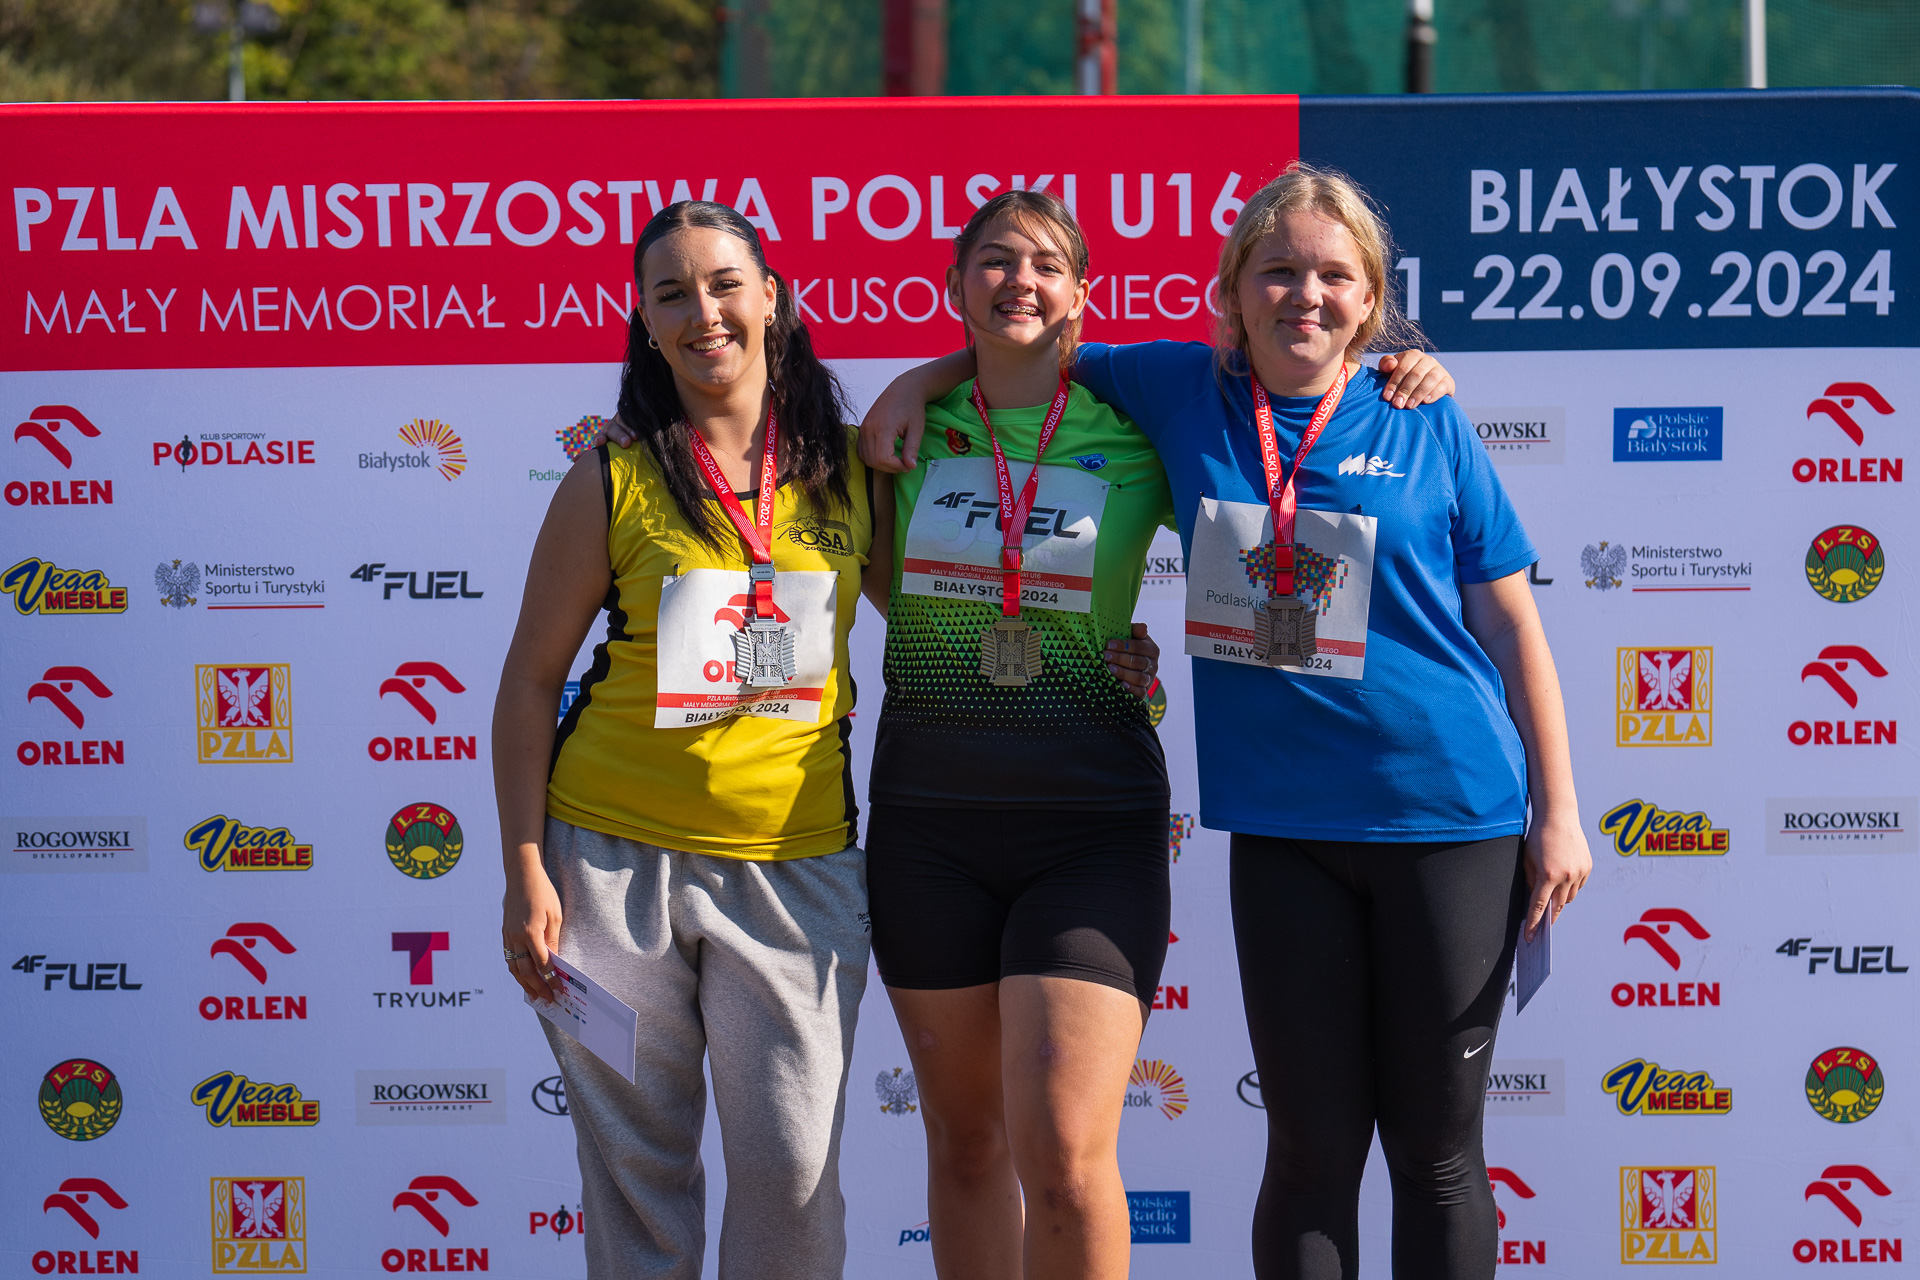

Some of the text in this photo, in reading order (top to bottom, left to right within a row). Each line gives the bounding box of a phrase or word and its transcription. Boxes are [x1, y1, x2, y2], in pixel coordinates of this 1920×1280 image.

[1470, 162, 1899, 235] BIAŁYSTOK
[12, 185, 198, 252] PZLA
[811, 174, 1078, 241] POLSI
[1110, 171, 1246, 239] U16
[1395, 249, 1896, 321] 1-22.09.2024
[24, 288, 178, 336] MAŁY
[199, 284, 505, 334] MEMORIAŁ
[1475, 421, 1547, 440] OWSKI
[1659, 413, 1709, 425] Polskie
[200, 432, 266, 441] KLUB SPORTOWY
[1659, 425, 1709, 439] Radio
[153, 440, 316, 467] PODLASIE
[358, 450, 431, 473] Białystok
[1263, 433, 1277, 471] POLSKI
[529, 468, 567, 482] Podlas
[1792, 457, 1903, 483] ORLEN
[4, 480, 114, 507] ORLEN
[763, 466, 773, 502] POLSKI
[997, 454, 1013, 519] POLSKI 2024
[1269, 473, 1282, 499] 2024
[760, 502, 770, 527] 2024
[799, 530, 847, 551] OSA
[1632, 544, 1723, 559] Ministerstwo
[1816, 528, 1872, 553] LZS
[205, 564, 295, 578] Ministerstwo
[982, 574, 1004, 582] JANUS
[1631, 562, 1752, 579] Sportu i Turystyki
[4, 560, 106, 612] Vega
[205, 580, 325, 597] Sportu i Turystyki
[383, 571, 485, 600] FUEL
[934, 580, 1058, 604] BIAŁYSTO 2024
[45, 590, 127, 610] MEBLE
[1206, 589, 1267, 610] Podlaskie
[1232, 628, 1246, 636] PZLA
[755, 702, 789, 714] 2024
[1621, 713, 1706, 742] PZLA
[1788, 720, 1897, 746] ORLEN
[17, 740, 125, 766] ORLEN
[202, 730, 288, 759] PZLA
[368, 735, 477, 761] ORLEN
[396, 805, 450, 830] LZS
[1605, 802, 1709, 853] Vega
[1784, 811, 1900, 829] ROGOWSKI
[16, 830, 130, 848] ROGOWSKI
[189, 817, 291, 869] Vega
[1645, 832, 1728, 851] MEBLE
[1800, 833, 1885, 841] DEVELOPMENT
[230, 847, 311, 867] MEBLE
[1809, 945, 1909, 975] FUEL
[45, 963, 143, 991] FUEL
[373, 991, 471, 1008] TRYUMF
[1611, 982, 1721, 1007] ORLEN
[199, 996, 307, 1021] ORLEN
[1816, 1050, 1870, 1073] LZS
[52, 1063, 106, 1086] LZS
[1607, 1061, 1710, 1112] Vega
[197, 1073, 299, 1123] Vega
[374, 1083, 488, 1100] ROGOWSKI
[1648, 1091, 1730, 1110] MEBLE
[237, 1102, 318, 1121] MEBLE
[1130, 1221, 1177, 1239] ystok
[217, 1242, 301, 1269] PZLA
[1626, 1233, 1711, 1260] PZLA
[1792, 1239, 1903, 1263] ORLEN
[32, 1250, 139, 1275] ORLEN
[381, 1248, 489, 1273] ORLEN
